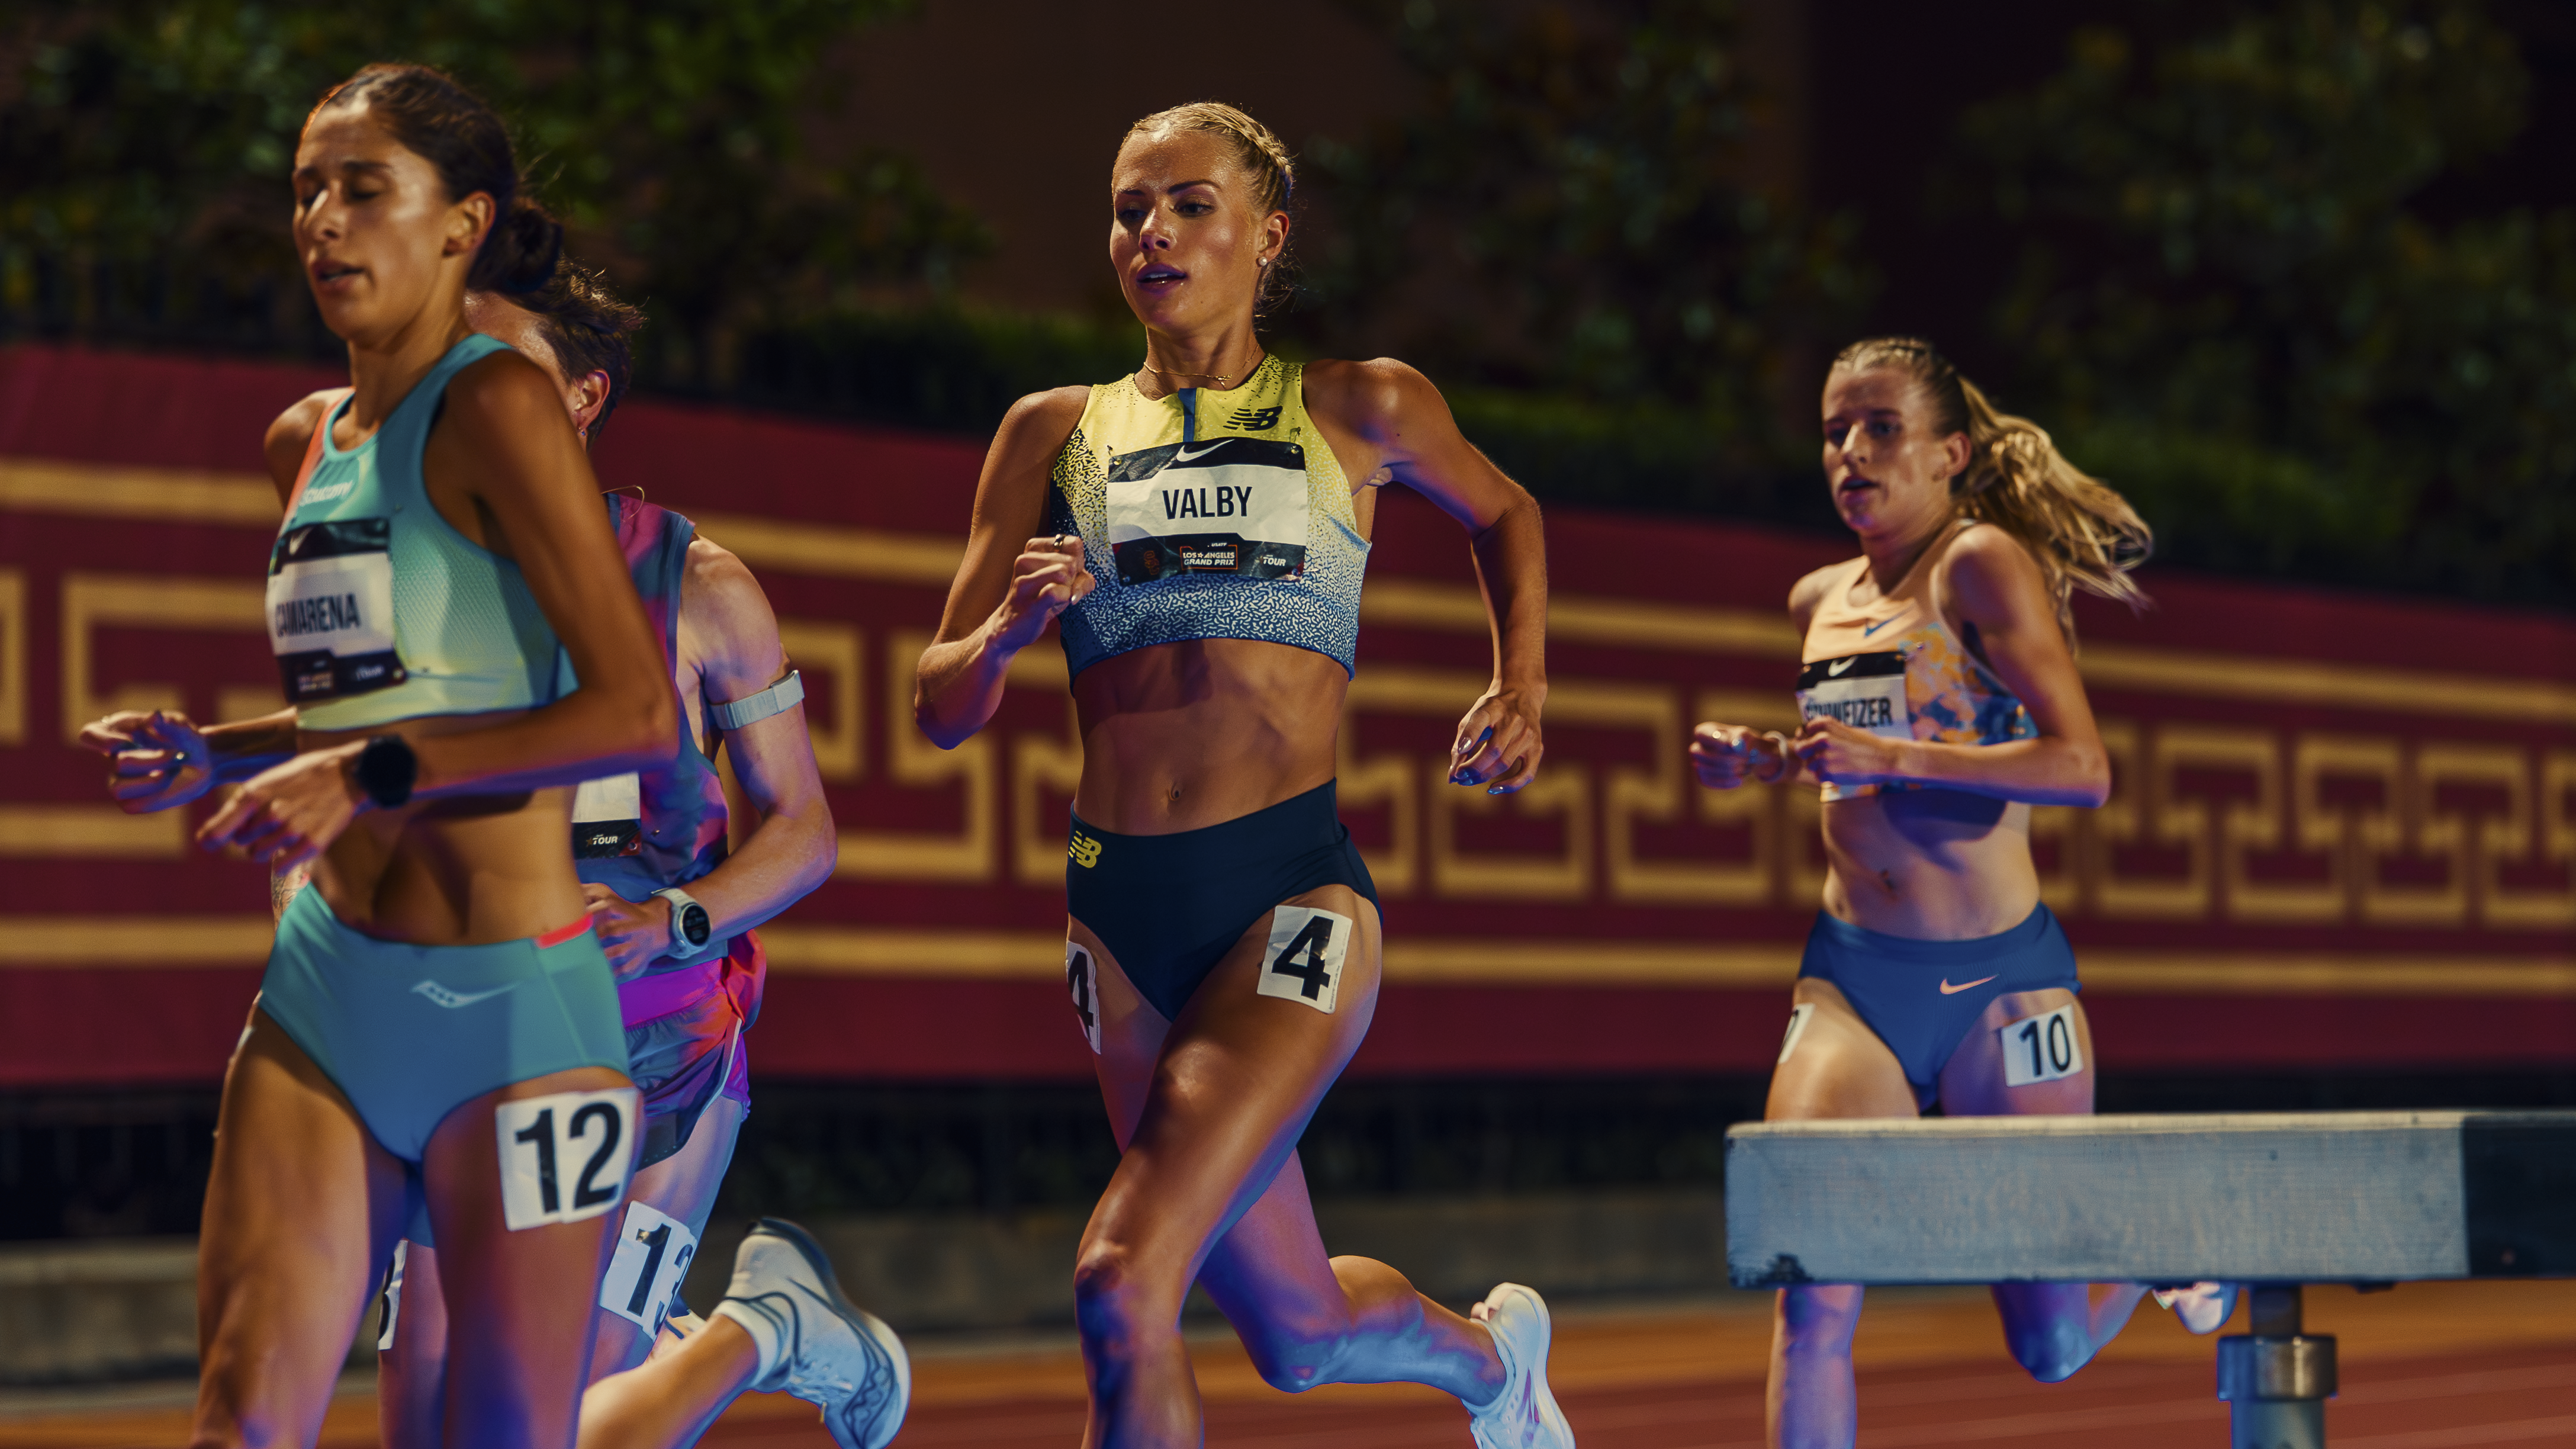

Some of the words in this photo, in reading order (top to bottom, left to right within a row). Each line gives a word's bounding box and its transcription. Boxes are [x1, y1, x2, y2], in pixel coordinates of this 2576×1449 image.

[1162, 486, 1253, 520] VALBY
[1263, 557, 1287, 567] TOUR
[593, 836, 618, 845] TOUR
[1271, 915, 1334, 1001] 4
[2020, 1014, 2072, 1077] 10
[514, 1101, 622, 1215] 12
